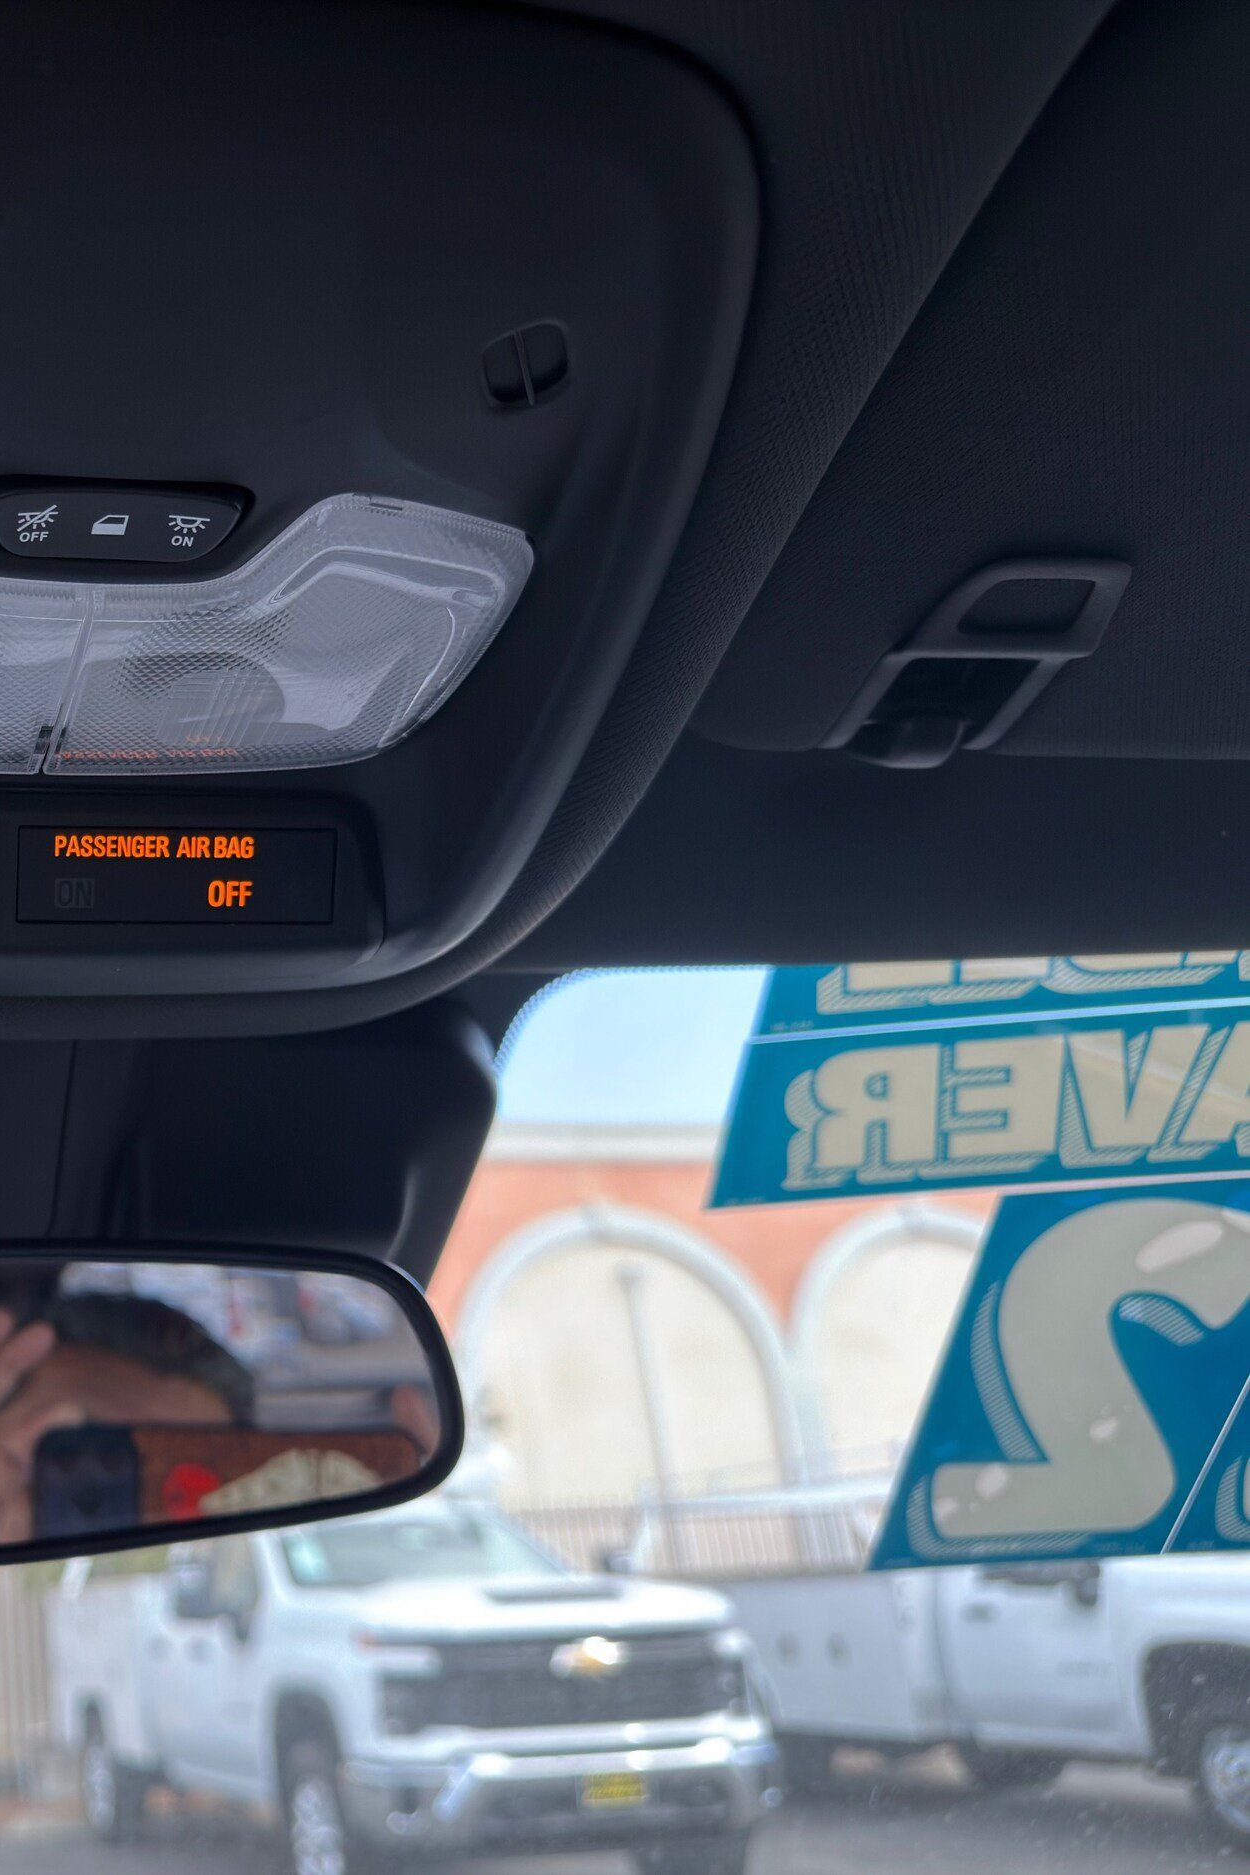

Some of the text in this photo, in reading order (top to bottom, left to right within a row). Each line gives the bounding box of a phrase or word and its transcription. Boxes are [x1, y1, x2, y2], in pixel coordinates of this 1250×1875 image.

[19, 531, 49, 543] OFF
[171, 535, 194, 547] ON
[54, 834, 254, 859] PASSENGER AIR BAG
[207, 879, 252, 907] OFF
